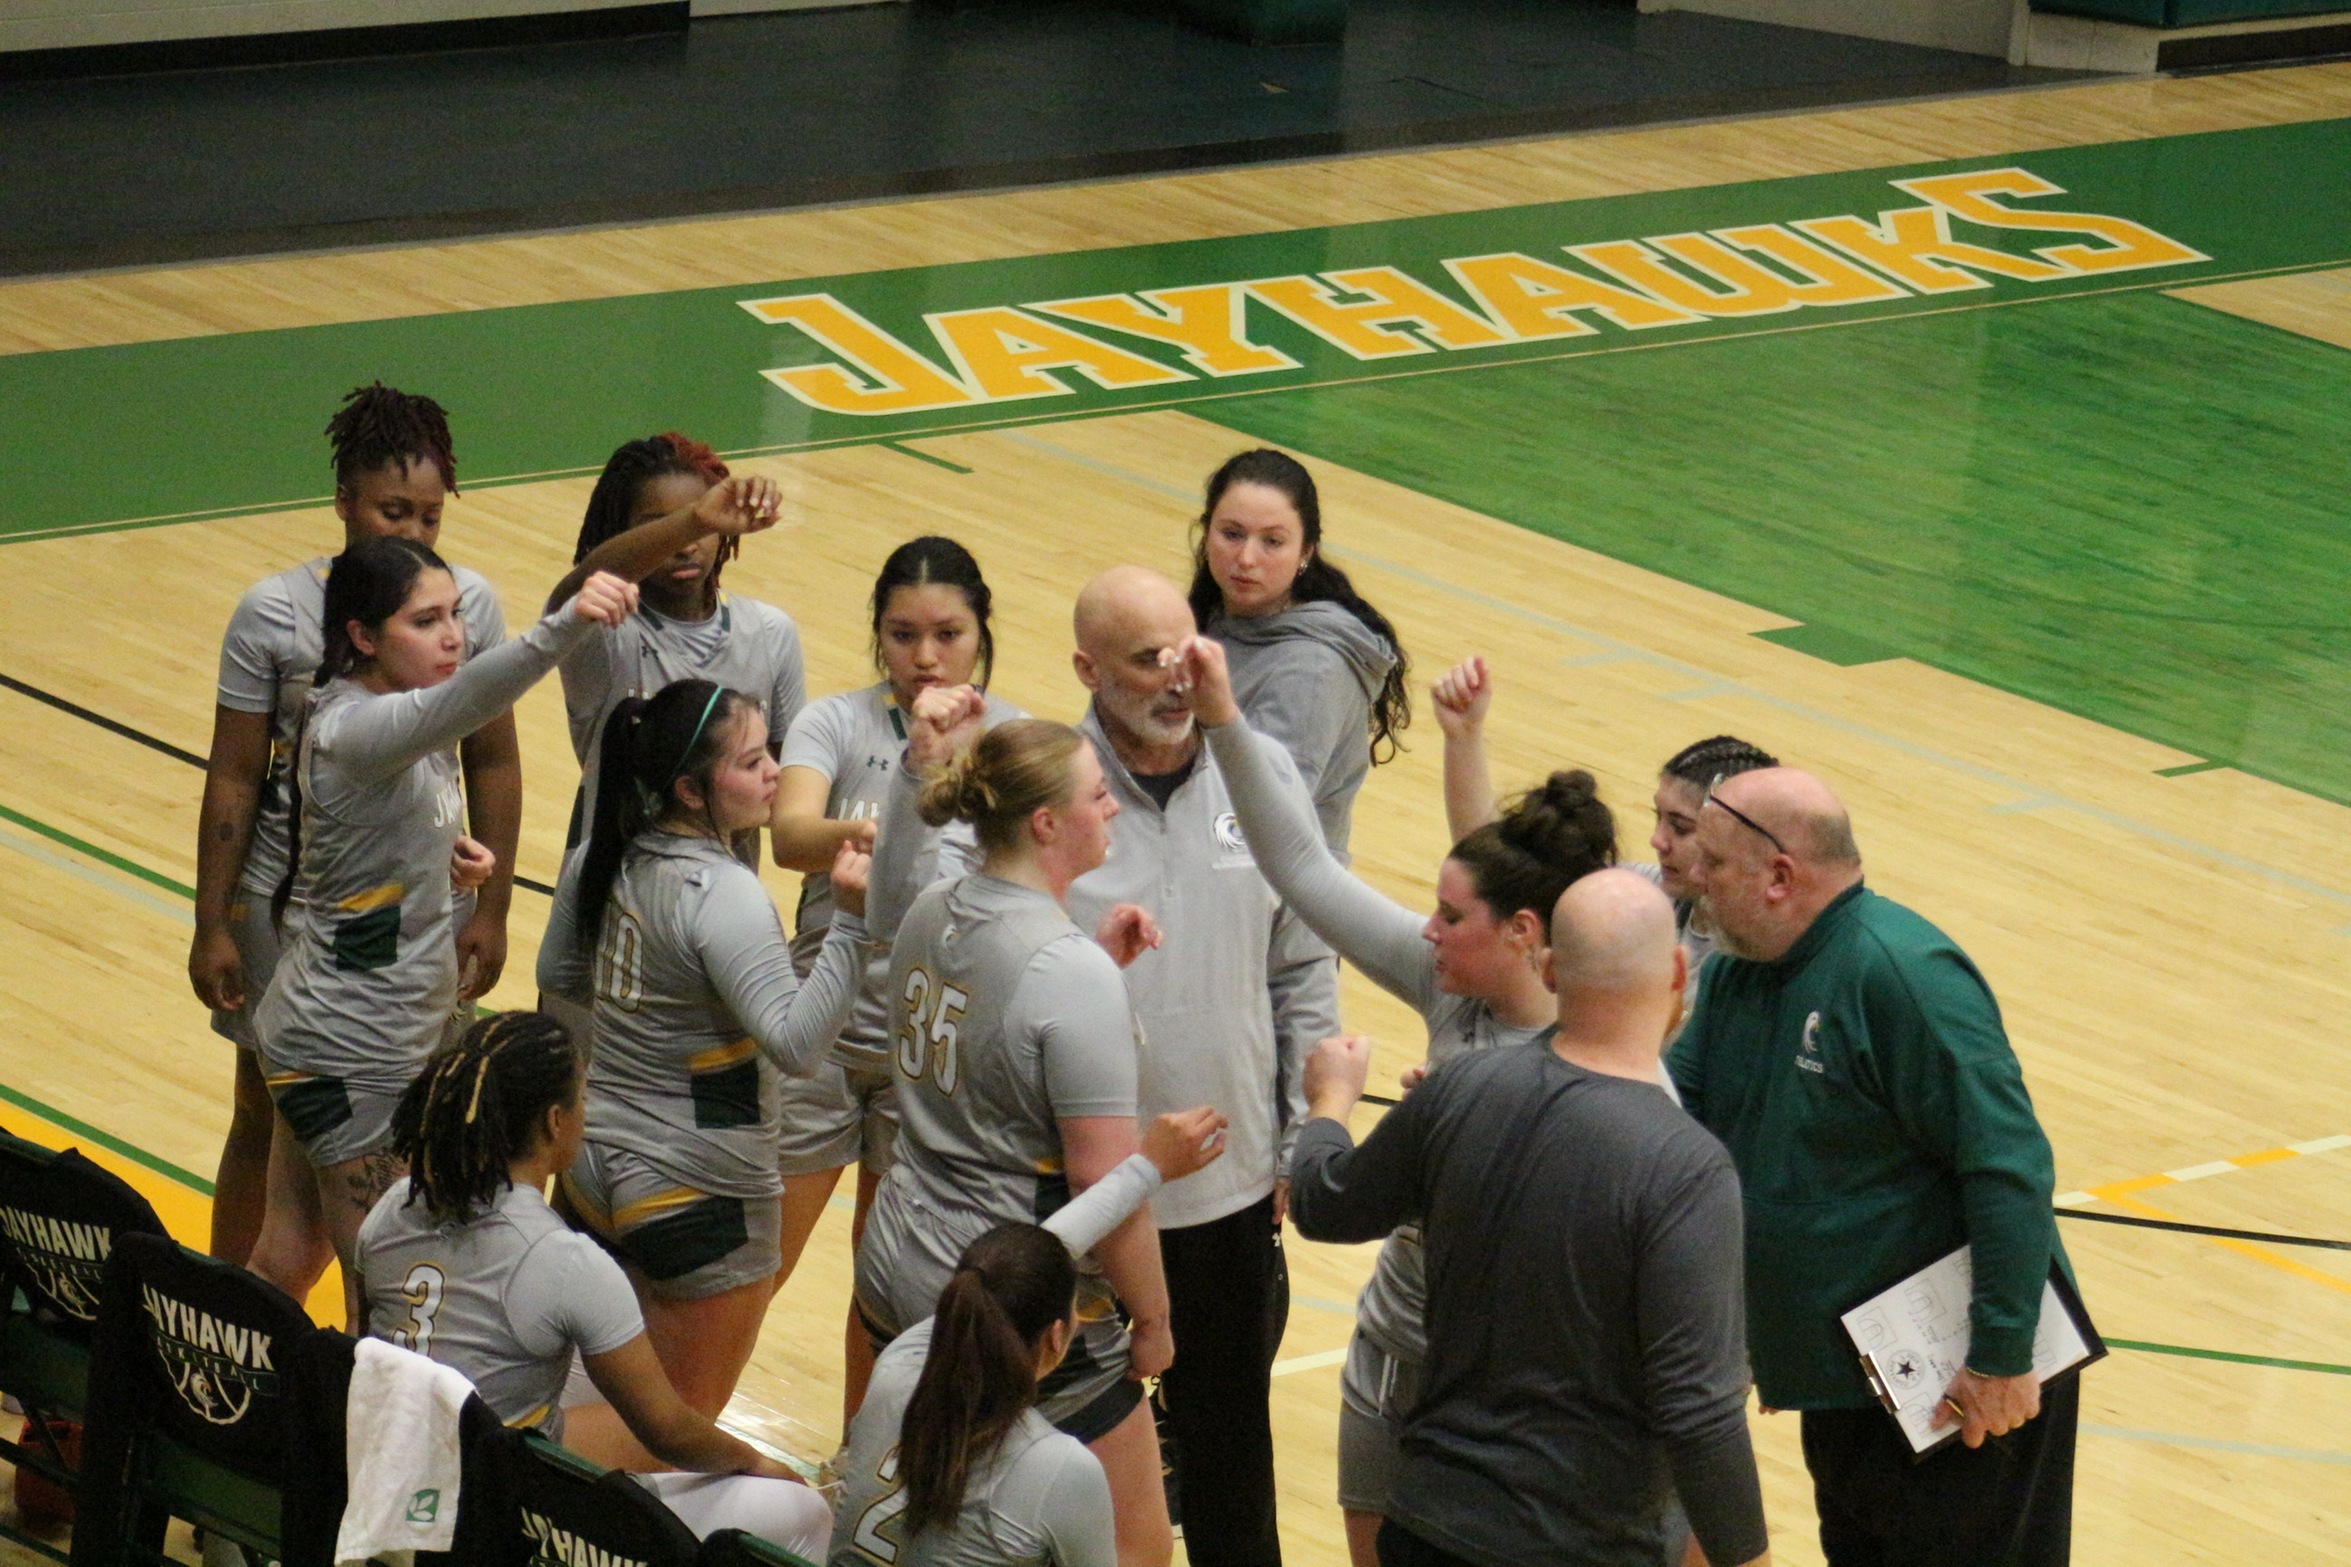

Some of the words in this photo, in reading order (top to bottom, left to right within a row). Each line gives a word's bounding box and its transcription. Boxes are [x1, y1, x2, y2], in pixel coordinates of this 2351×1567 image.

[735, 166, 2214, 415] JAYHAWKS
[898, 966, 970, 1098] 35
[392, 1262, 446, 1357] 3
